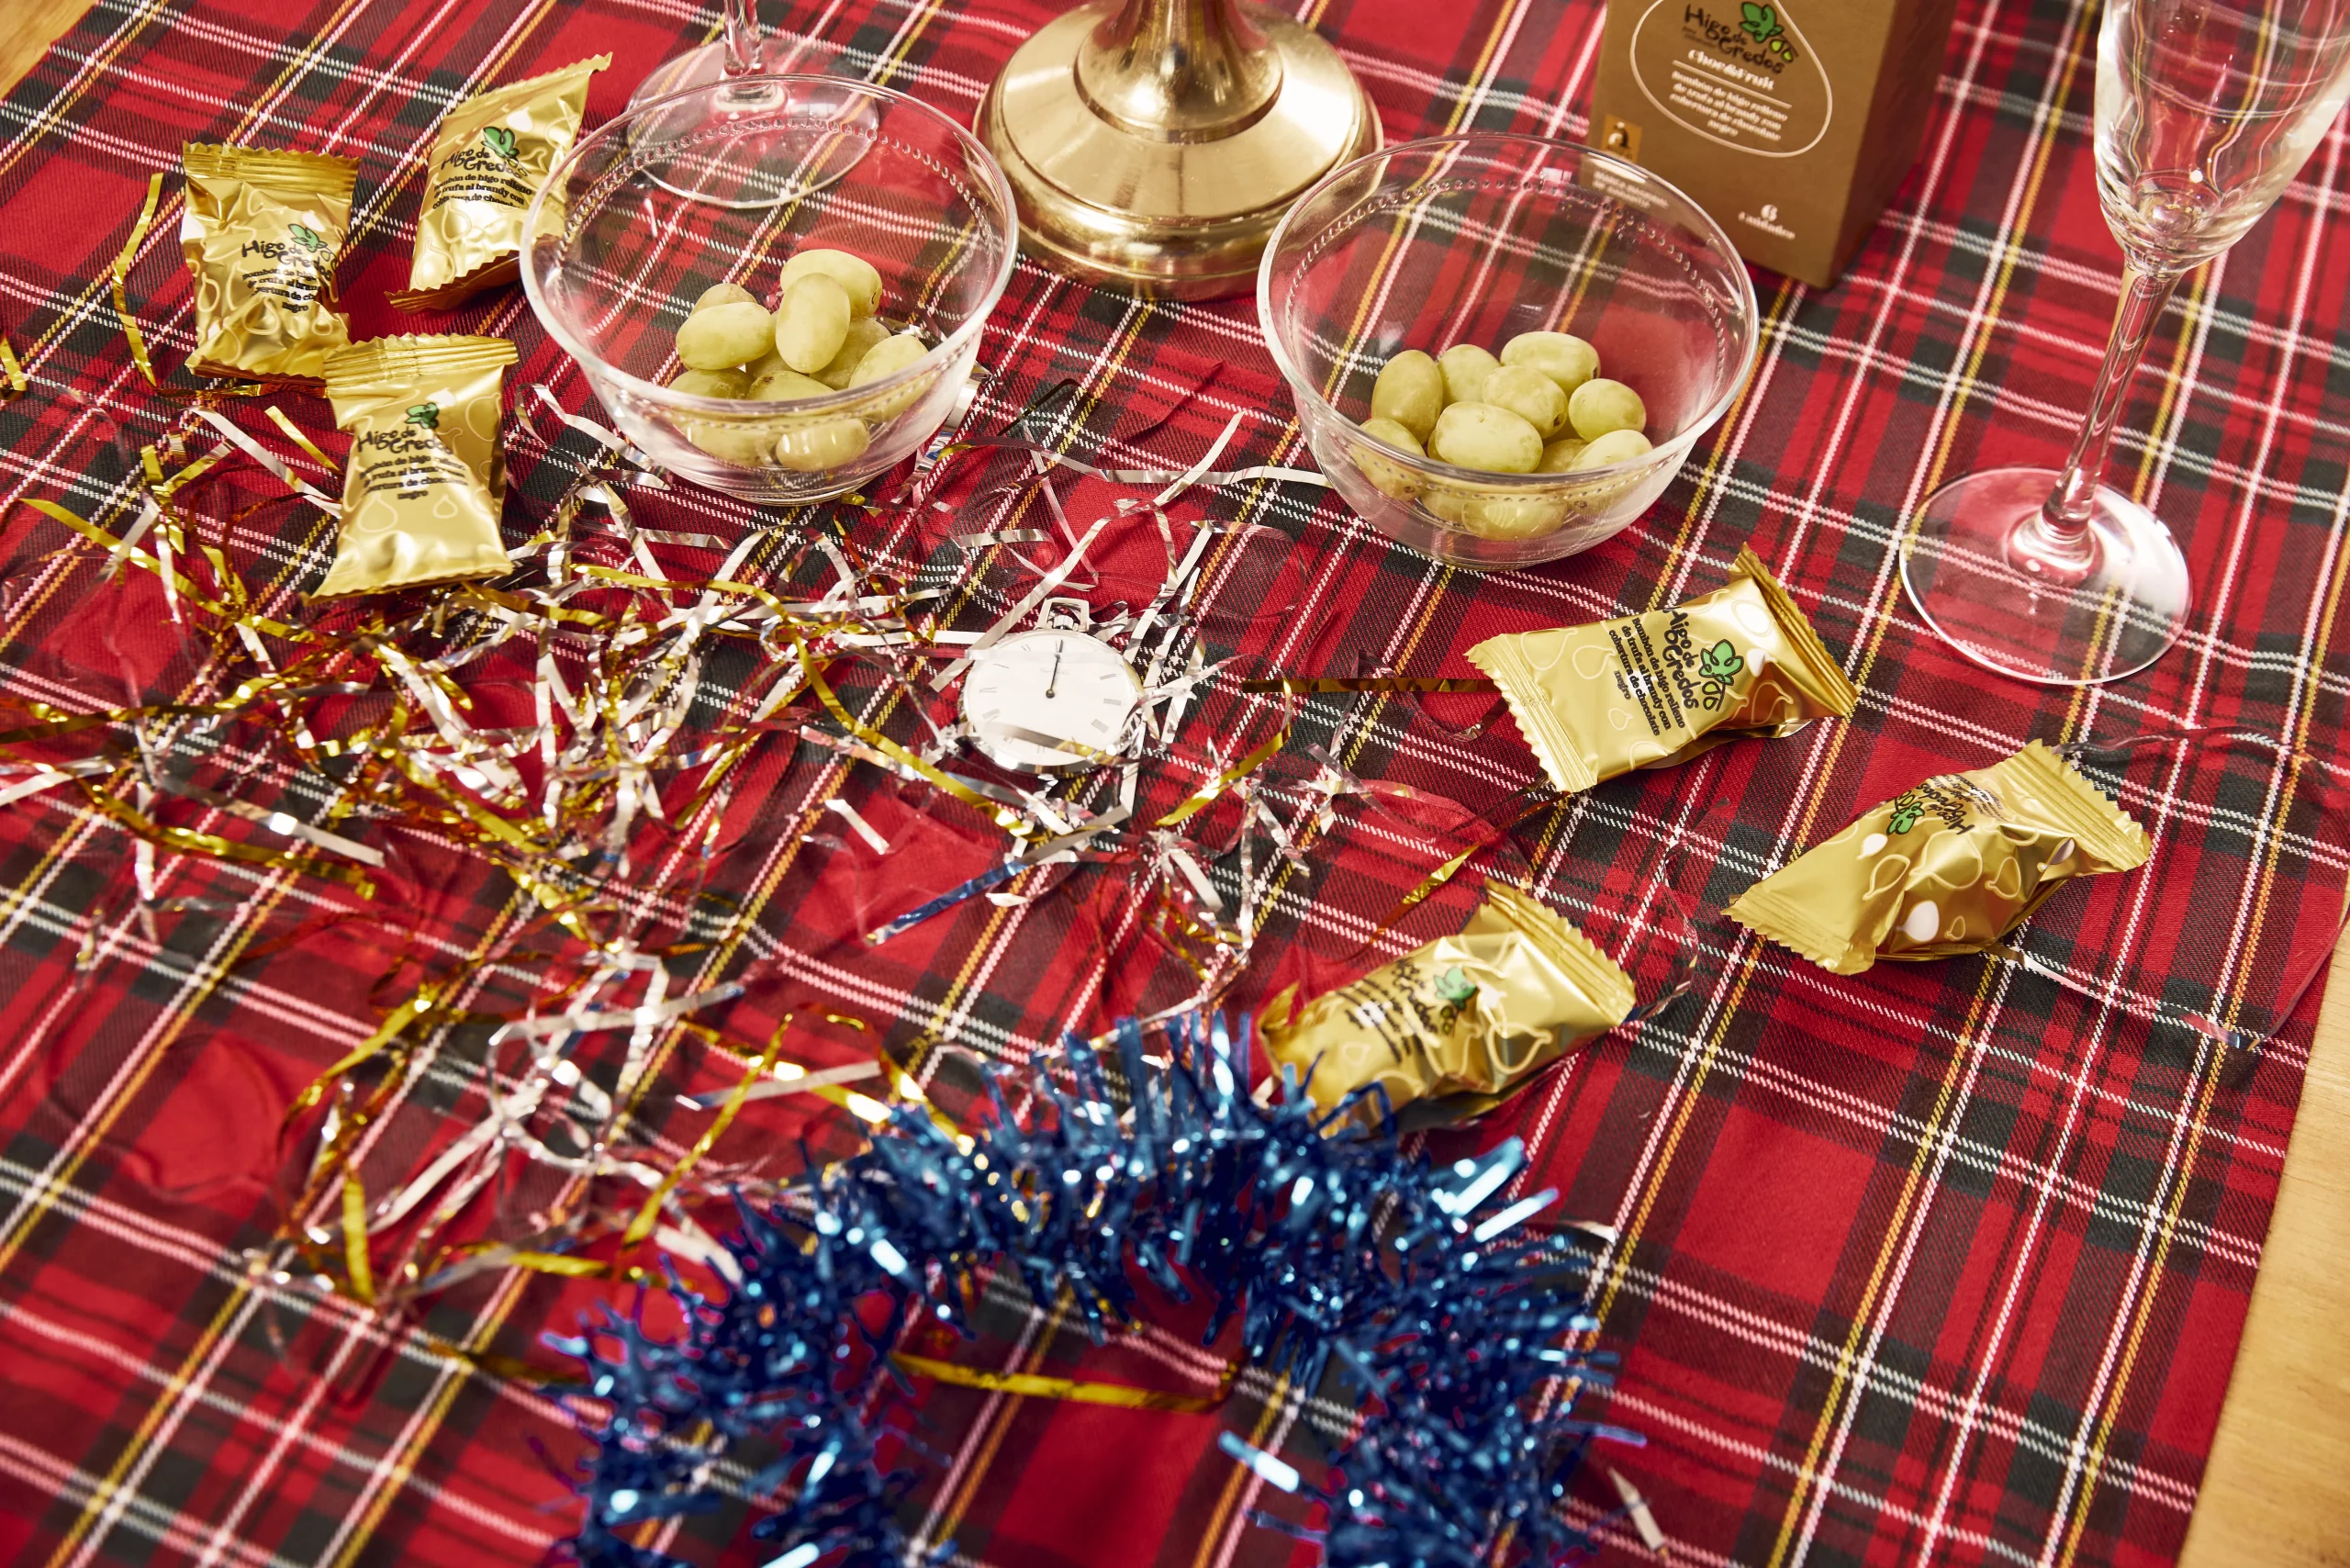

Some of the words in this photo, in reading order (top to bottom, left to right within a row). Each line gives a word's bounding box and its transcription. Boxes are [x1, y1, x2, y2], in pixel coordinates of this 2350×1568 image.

[1684, 4, 1730, 41] Higo
[1732, 30, 1748, 46] de
[1718, 35, 1785, 74] Gredos
[441, 149, 474, 170] Higo
[476, 147, 490, 159] de
[464, 157, 523, 179] Gredos
[476, 184, 509, 197] brandy
[509, 193, 524, 206] con
[477, 174, 498, 184] higo
[500, 178, 532, 196] relleno
[1761, 205, 1778, 221] 6
[241, 241, 285, 259] Higo
[289, 244, 303, 255] de
[278, 251, 332, 281] Gredos
[282, 301, 308, 313] negro
[358, 430, 397, 452] Higo
[401, 426, 417, 439] de
[407, 478, 419, 487] de
[1621, 625, 1632, 638] de
[1662, 606, 1693, 649] Higo
[1683, 651, 1699, 668] de
[1627, 636, 1642, 665] trufa
[1608, 629, 1633, 675] cobertura
[1628, 675, 1639, 689] de
[1635, 688, 1660, 736] chocolate
[1631, 617, 1654, 656] Bombón
[1649, 656, 1660, 671] de
[1655, 669, 1670, 694] higo
[1666, 693, 1685, 729] relleno
[1638, 664, 1651, 677] al
[1662, 644, 1700, 710] Gredos
[1613, 670, 1631, 700] negro
[1642, 672, 1664, 711] brandy
[1659, 710, 1672, 731] con
[1916, 783, 1964, 812] Gredos
[1936, 811, 1975, 835] Higo
